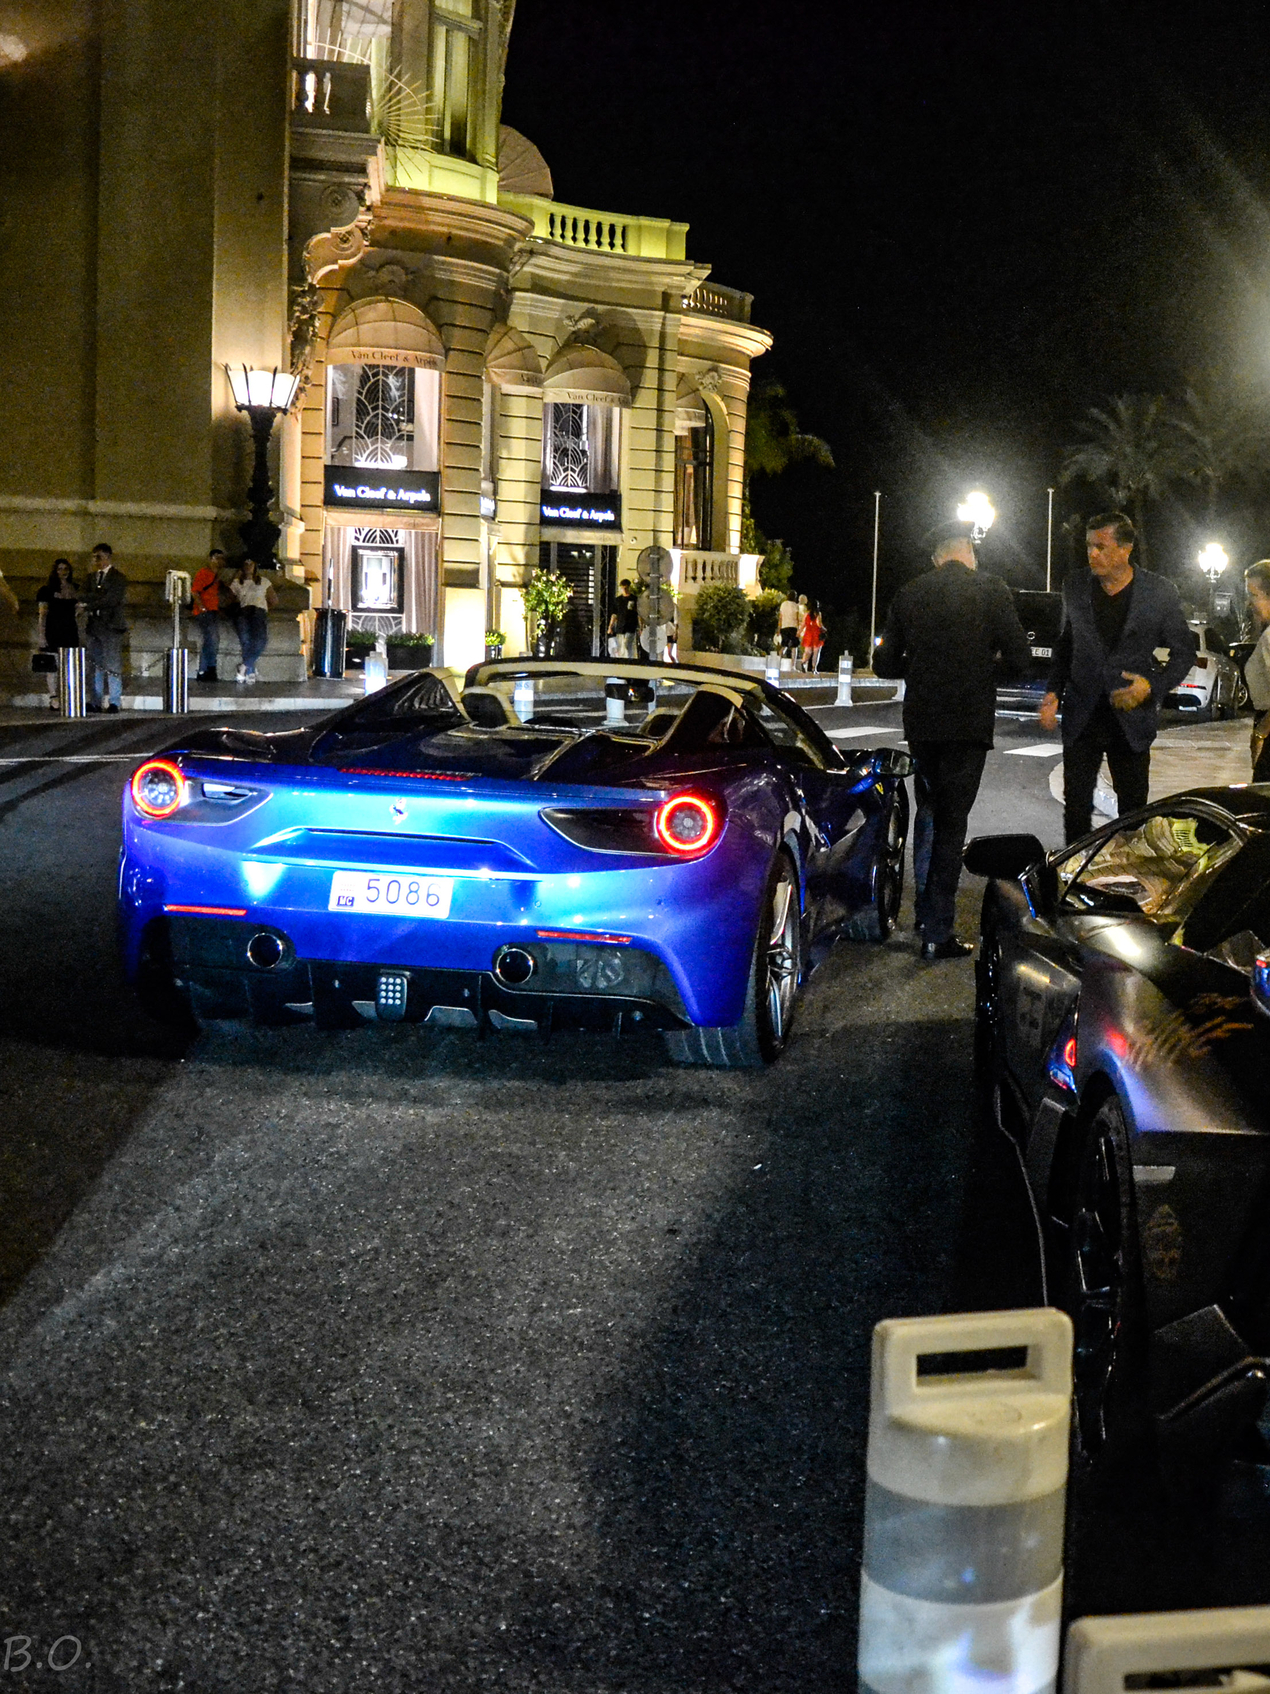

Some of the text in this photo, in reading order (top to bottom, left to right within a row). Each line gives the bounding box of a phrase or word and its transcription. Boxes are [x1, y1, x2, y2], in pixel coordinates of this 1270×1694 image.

[333, 483, 431, 504] Van Cleef & Arpels
[541, 505, 559, 518] Van
[559, 506, 582, 519] Cleef
[589, 507, 616, 523] Arpels
[366, 878, 440, 907] 5086
